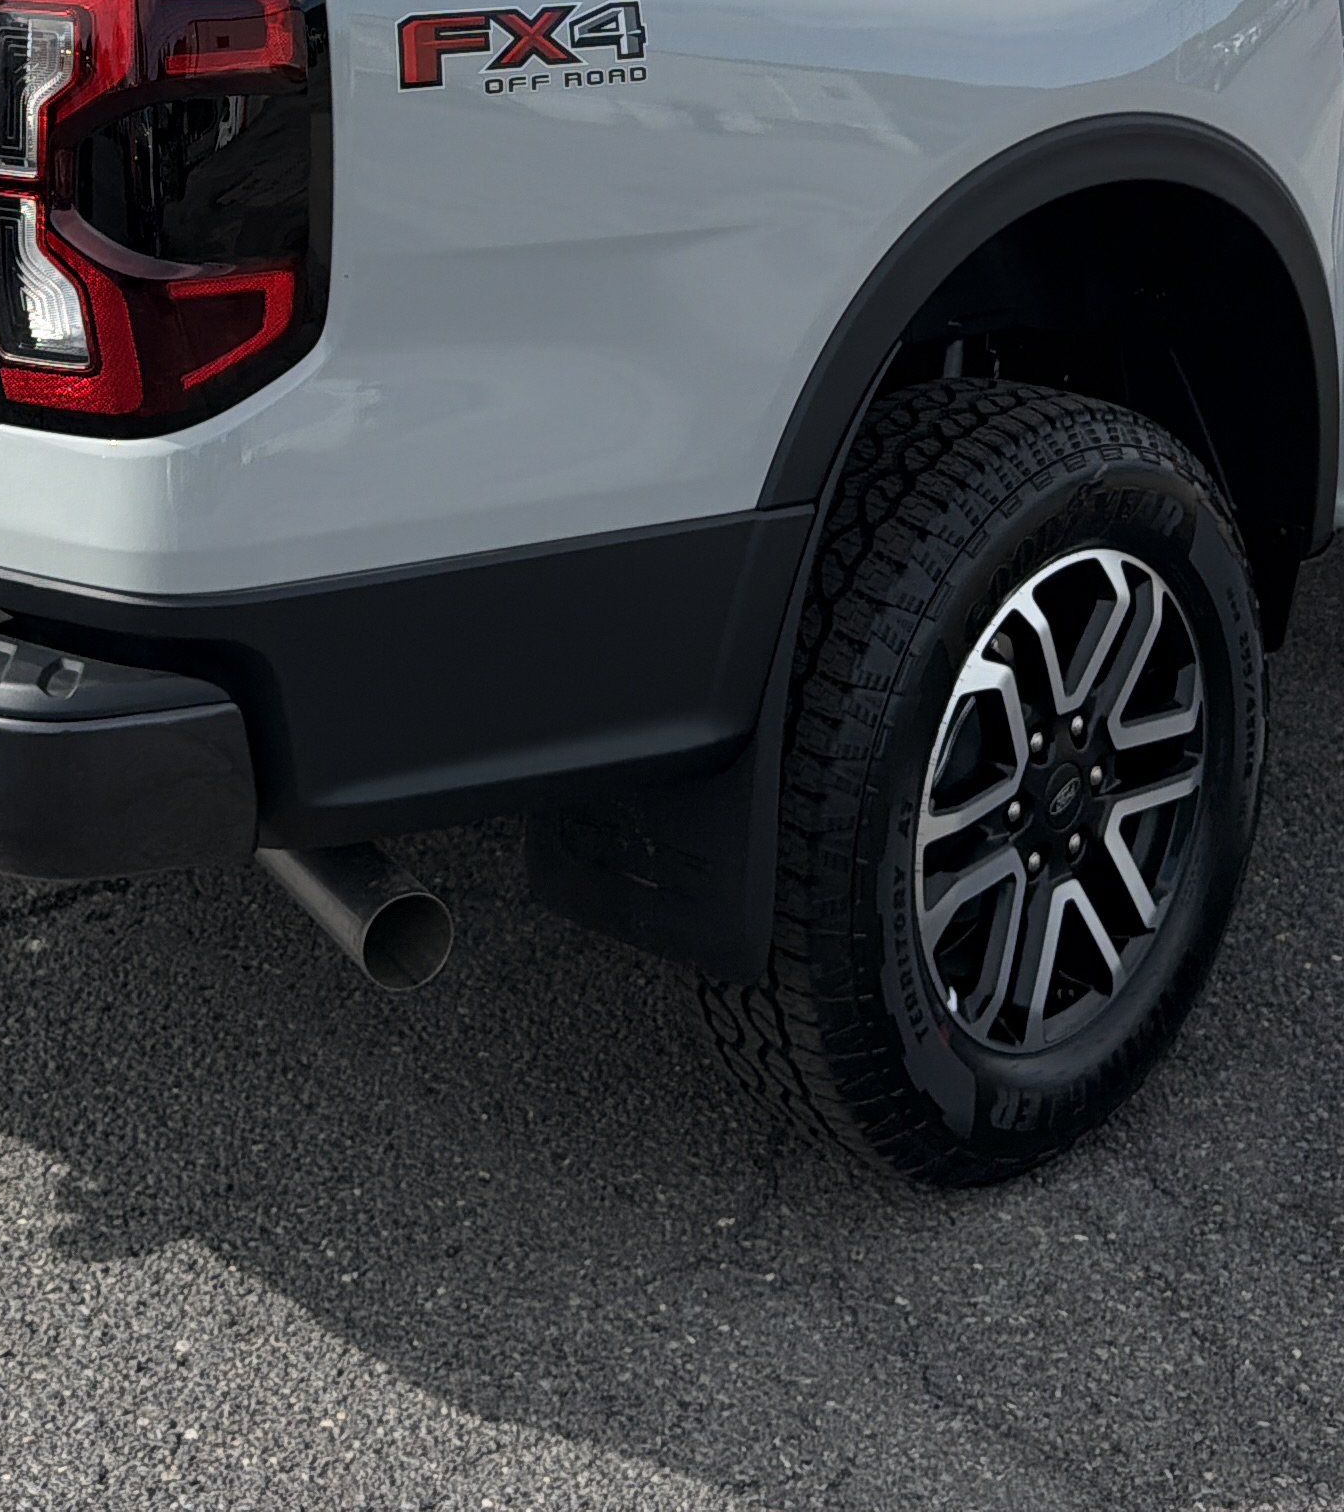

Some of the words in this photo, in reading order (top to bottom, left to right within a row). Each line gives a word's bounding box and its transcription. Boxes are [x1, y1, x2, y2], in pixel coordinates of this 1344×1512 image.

[396, 0, 647, 91] FX4
[484, 75, 550, 94] OFF
[564, 66, 647, 88] ROAD
